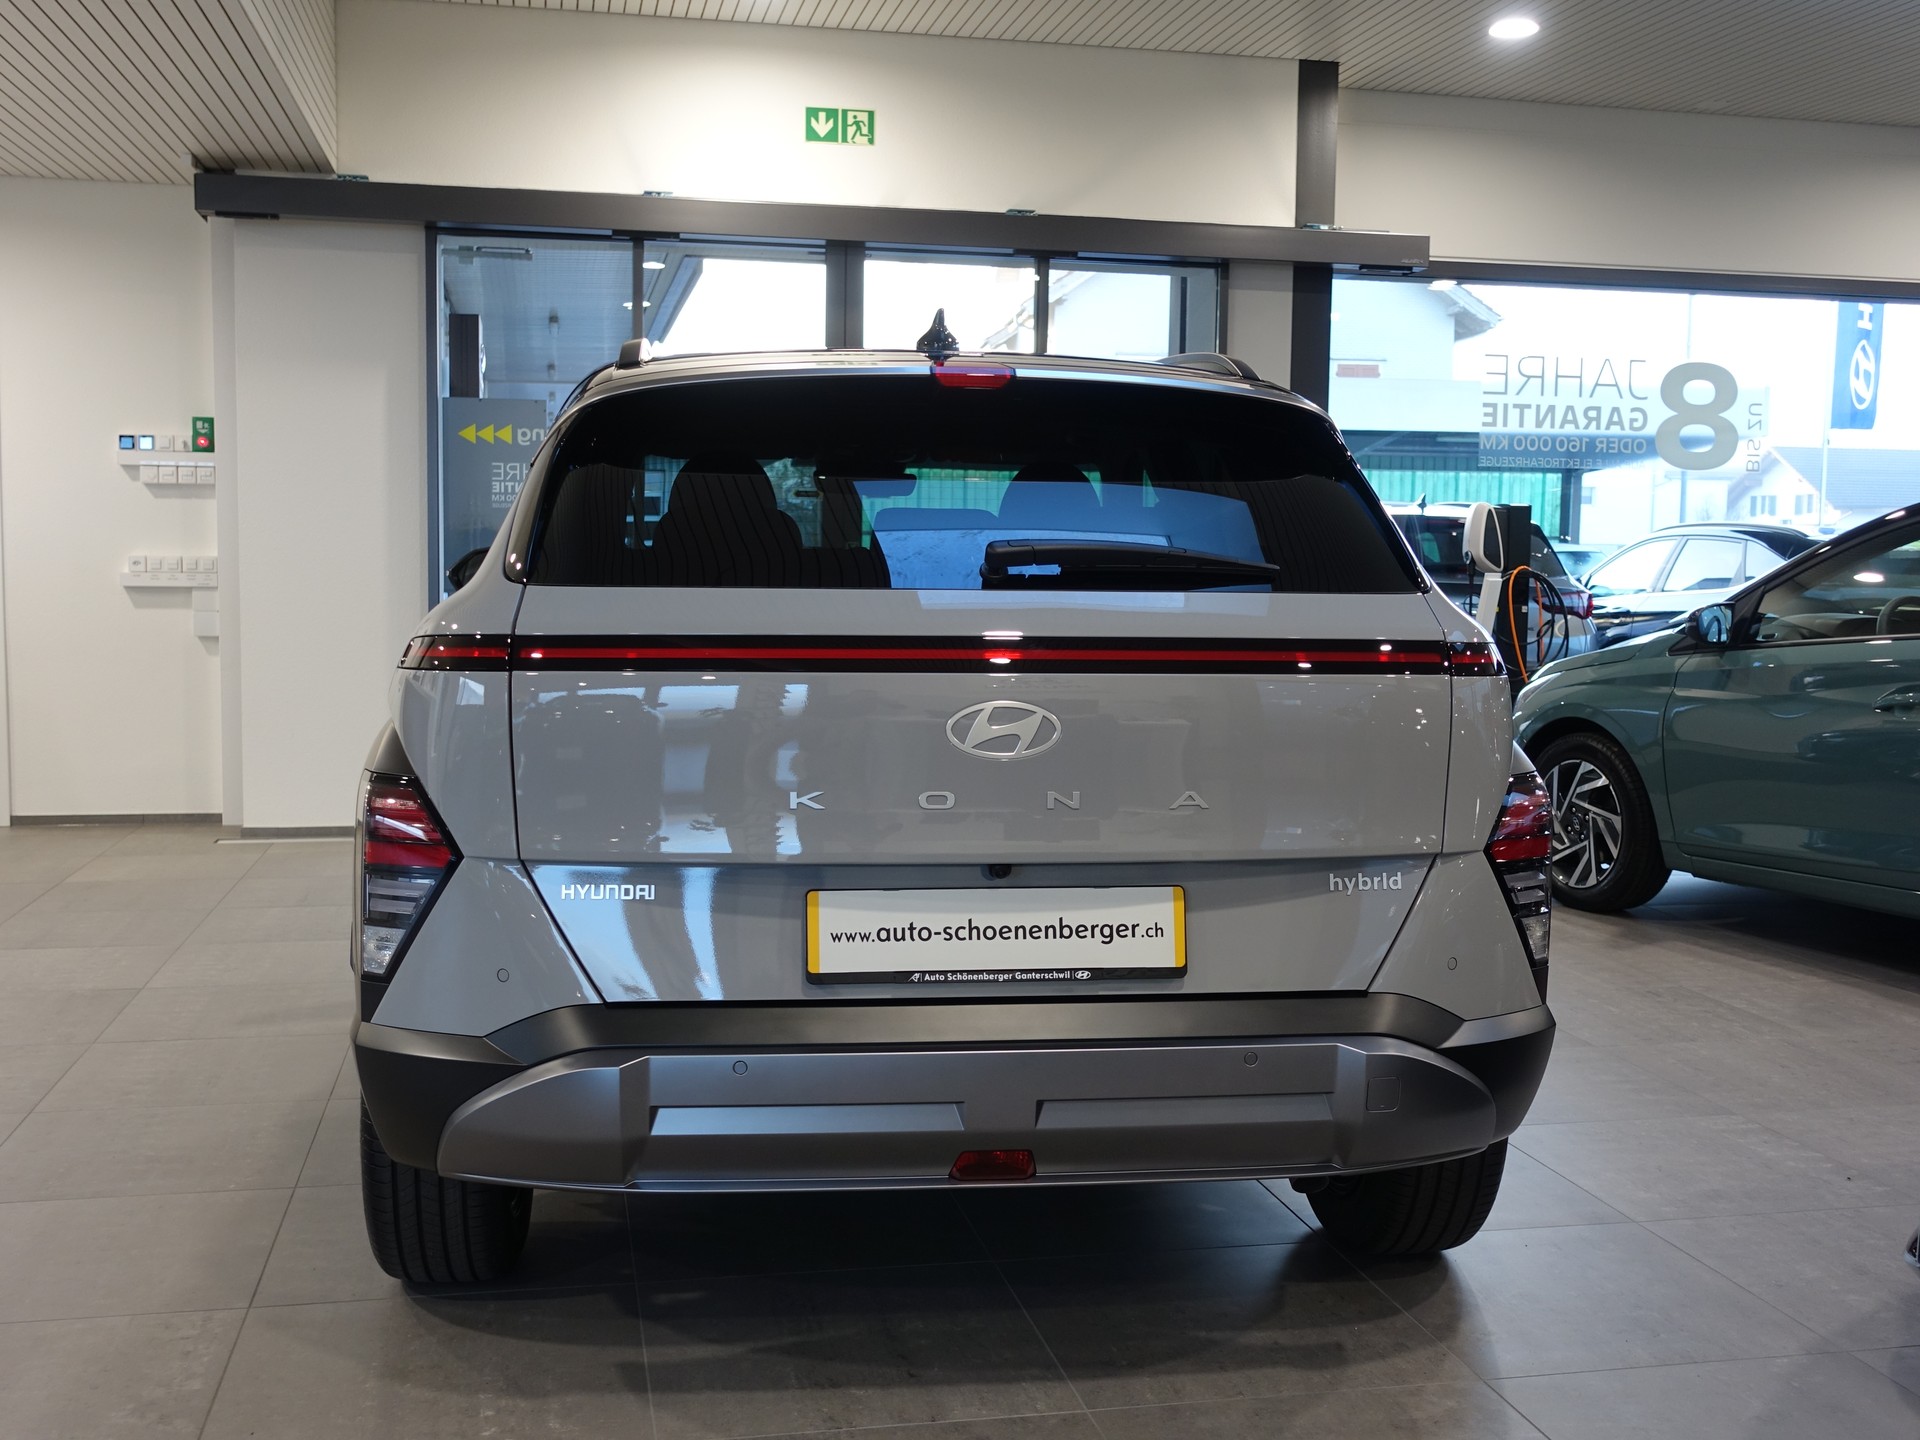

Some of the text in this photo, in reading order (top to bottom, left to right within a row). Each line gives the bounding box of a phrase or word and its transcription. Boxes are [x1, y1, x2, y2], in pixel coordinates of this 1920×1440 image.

[790, 787, 1210, 811] KONA
[560, 884, 656, 901] HYUNDAI
[1328, 871, 1403, 896] hybrid
[829, 916, 1166, 945] www.auto-schoenenberger.ch
[924, 973, 945, 982] Auto
[947, 971, 1013, 982] Schönenberger
[1015, 970, 1071, 981] Ganterschwil
